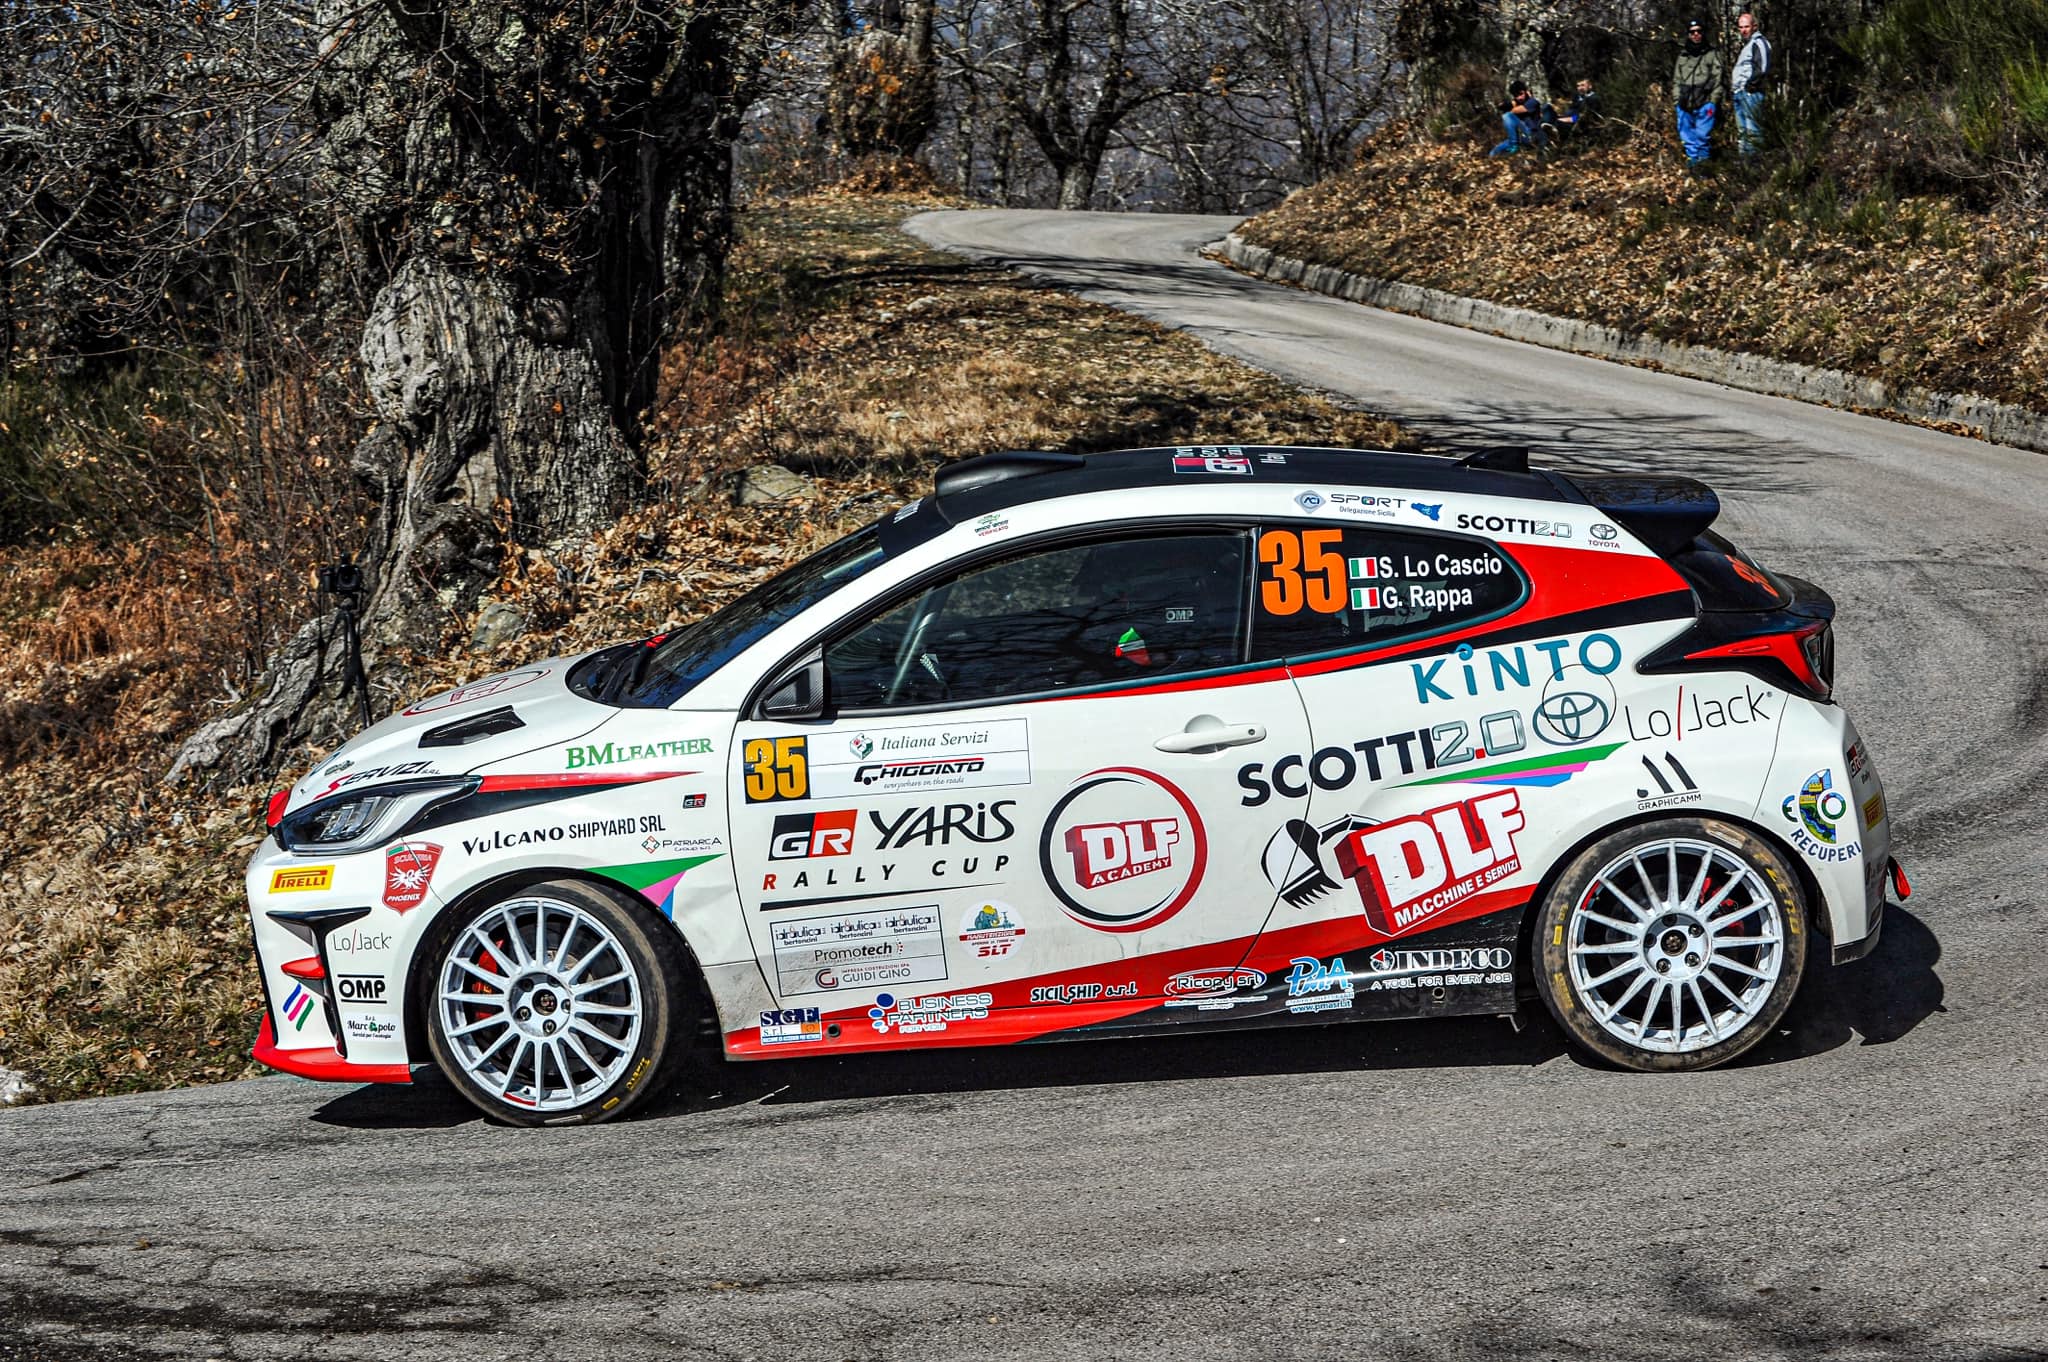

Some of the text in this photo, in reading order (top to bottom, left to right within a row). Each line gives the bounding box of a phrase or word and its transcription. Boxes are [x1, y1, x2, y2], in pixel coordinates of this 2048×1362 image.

[1330, 493, 1407, 509] SPORT
[1587, 539, 1621, 549] TOYOTA
[1258, 528, 1349, 616] 35
[1379, 552, 1502, 578] S. Lo Cascio
[1382, 585, 1473, 612] G. Rappa
[1165, 609, 1194, 621] OMP
[880, 730, 989, 750] Italiana Servizi
[745, 736, 807, 800] 35
[684, 797, 705, 808] GR
[1637, 793, 1702, 811] GRAPHICAMM
[568, 817, 637, 839] SHIPYARD
[639, 814, 667, 833] SRL
[662, 837, 722, 848] PATRIARCA
[770, 821, 853, 859] GR
[1078, 819, 1180, 875] DLF
[1360, 791, 1525, 909] DLF
[1790, 827, 1862, 862] RECUPERI
[274, 869, 329, 890] PIRELLI
[762, 854, 1010, 891] RALLY CUP
[1090, 857, 1170, 888] ACADEMY
[386, 893, 421, 902] PHOENIX
[1393, 858, 1518, 928] MACCHINE E SERVIZI
[839, 930, 873, 940] bertoncini
[813, 942, 893, 962] Promotech
[977, 943, 1012, 957] SLT
[1395, 947, 1513, 970] INDECO
[842, 967, 911, 983] GUIDI GINO
[1177, 973, 1260, 991] Ricopy srl
[1371, 972, 1513, 990] A TOOL FOR EVERY JOB
[338, 977, 386, 999] OMP
[898, 994, 992, 1011] BUSINESS
[887, 1007, 988, 1025] PARTNERS
